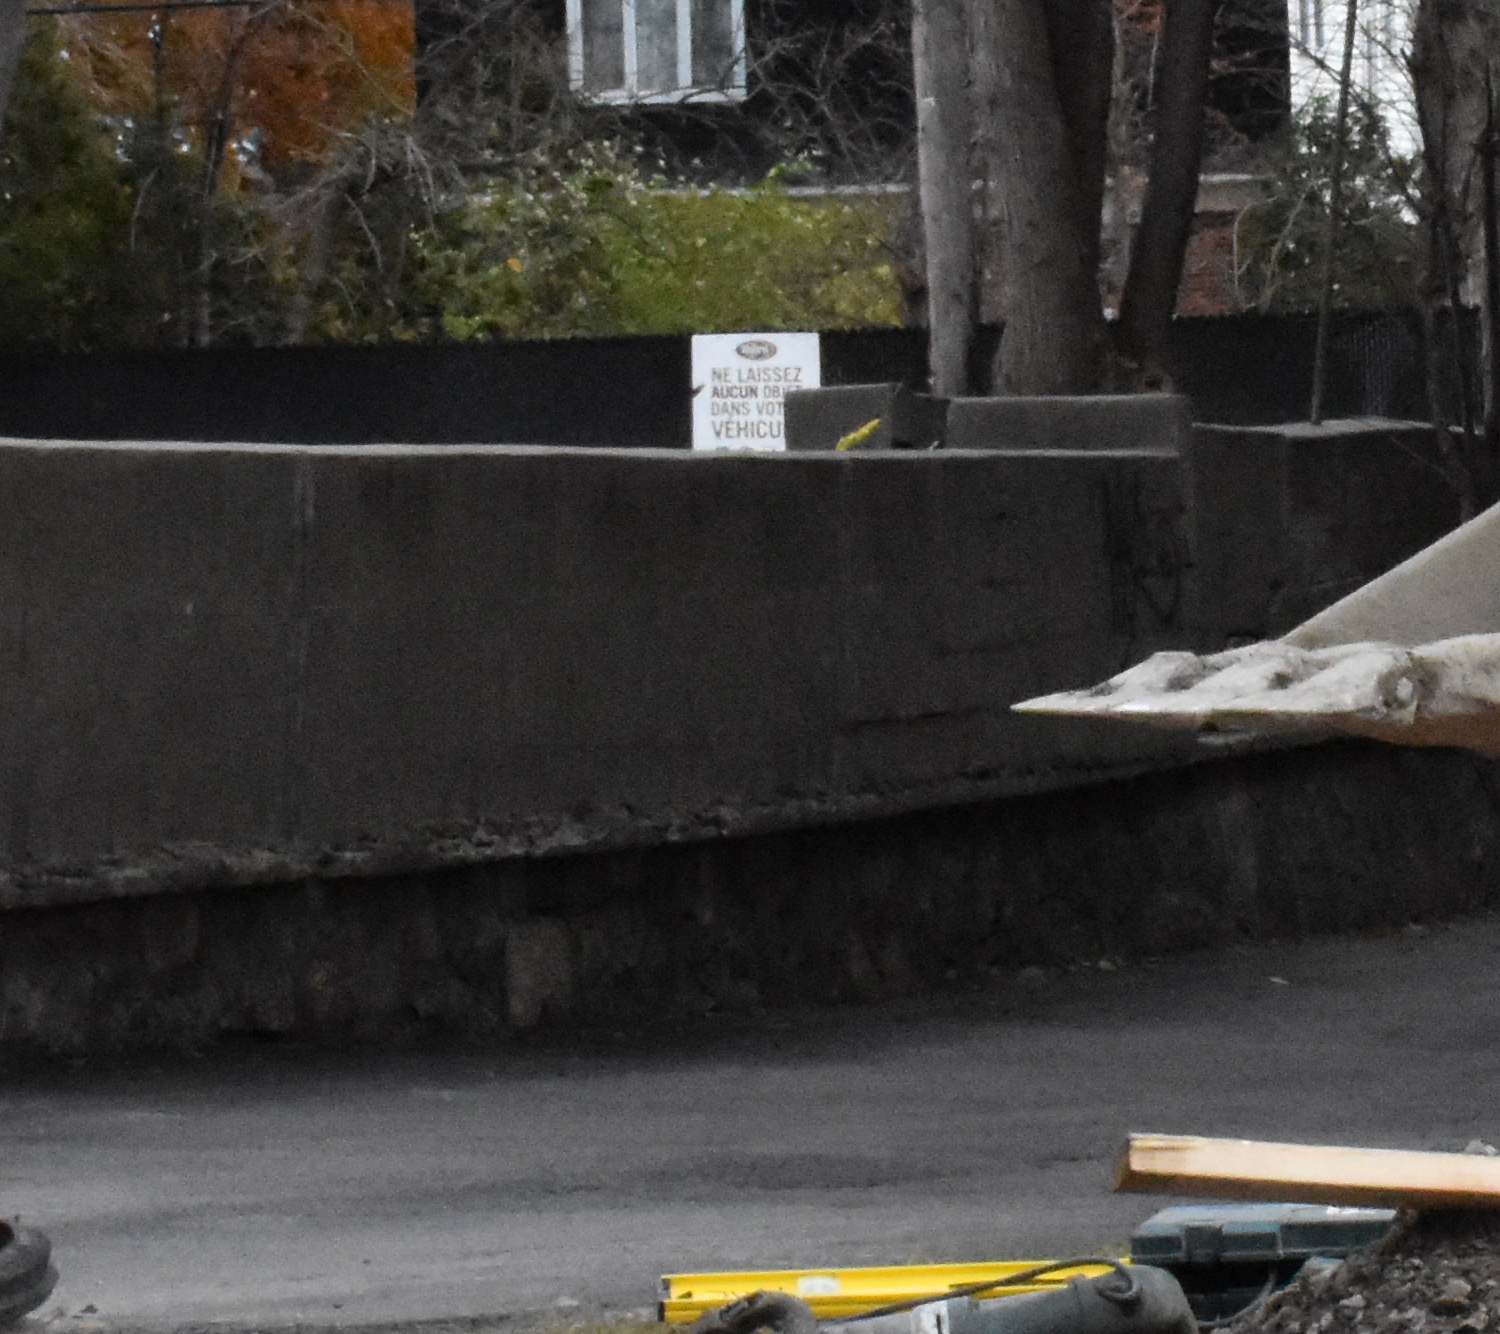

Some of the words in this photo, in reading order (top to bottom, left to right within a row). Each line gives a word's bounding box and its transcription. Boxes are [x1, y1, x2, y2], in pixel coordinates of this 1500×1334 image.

[711, 367, 732, 383] NE
[737, 367, 803, 383] LAISSEZ
[711, 385, 759, 399] AUCUN
[711, 401, 751, 416] DANS
[756, 401, 784, 416] VOT
